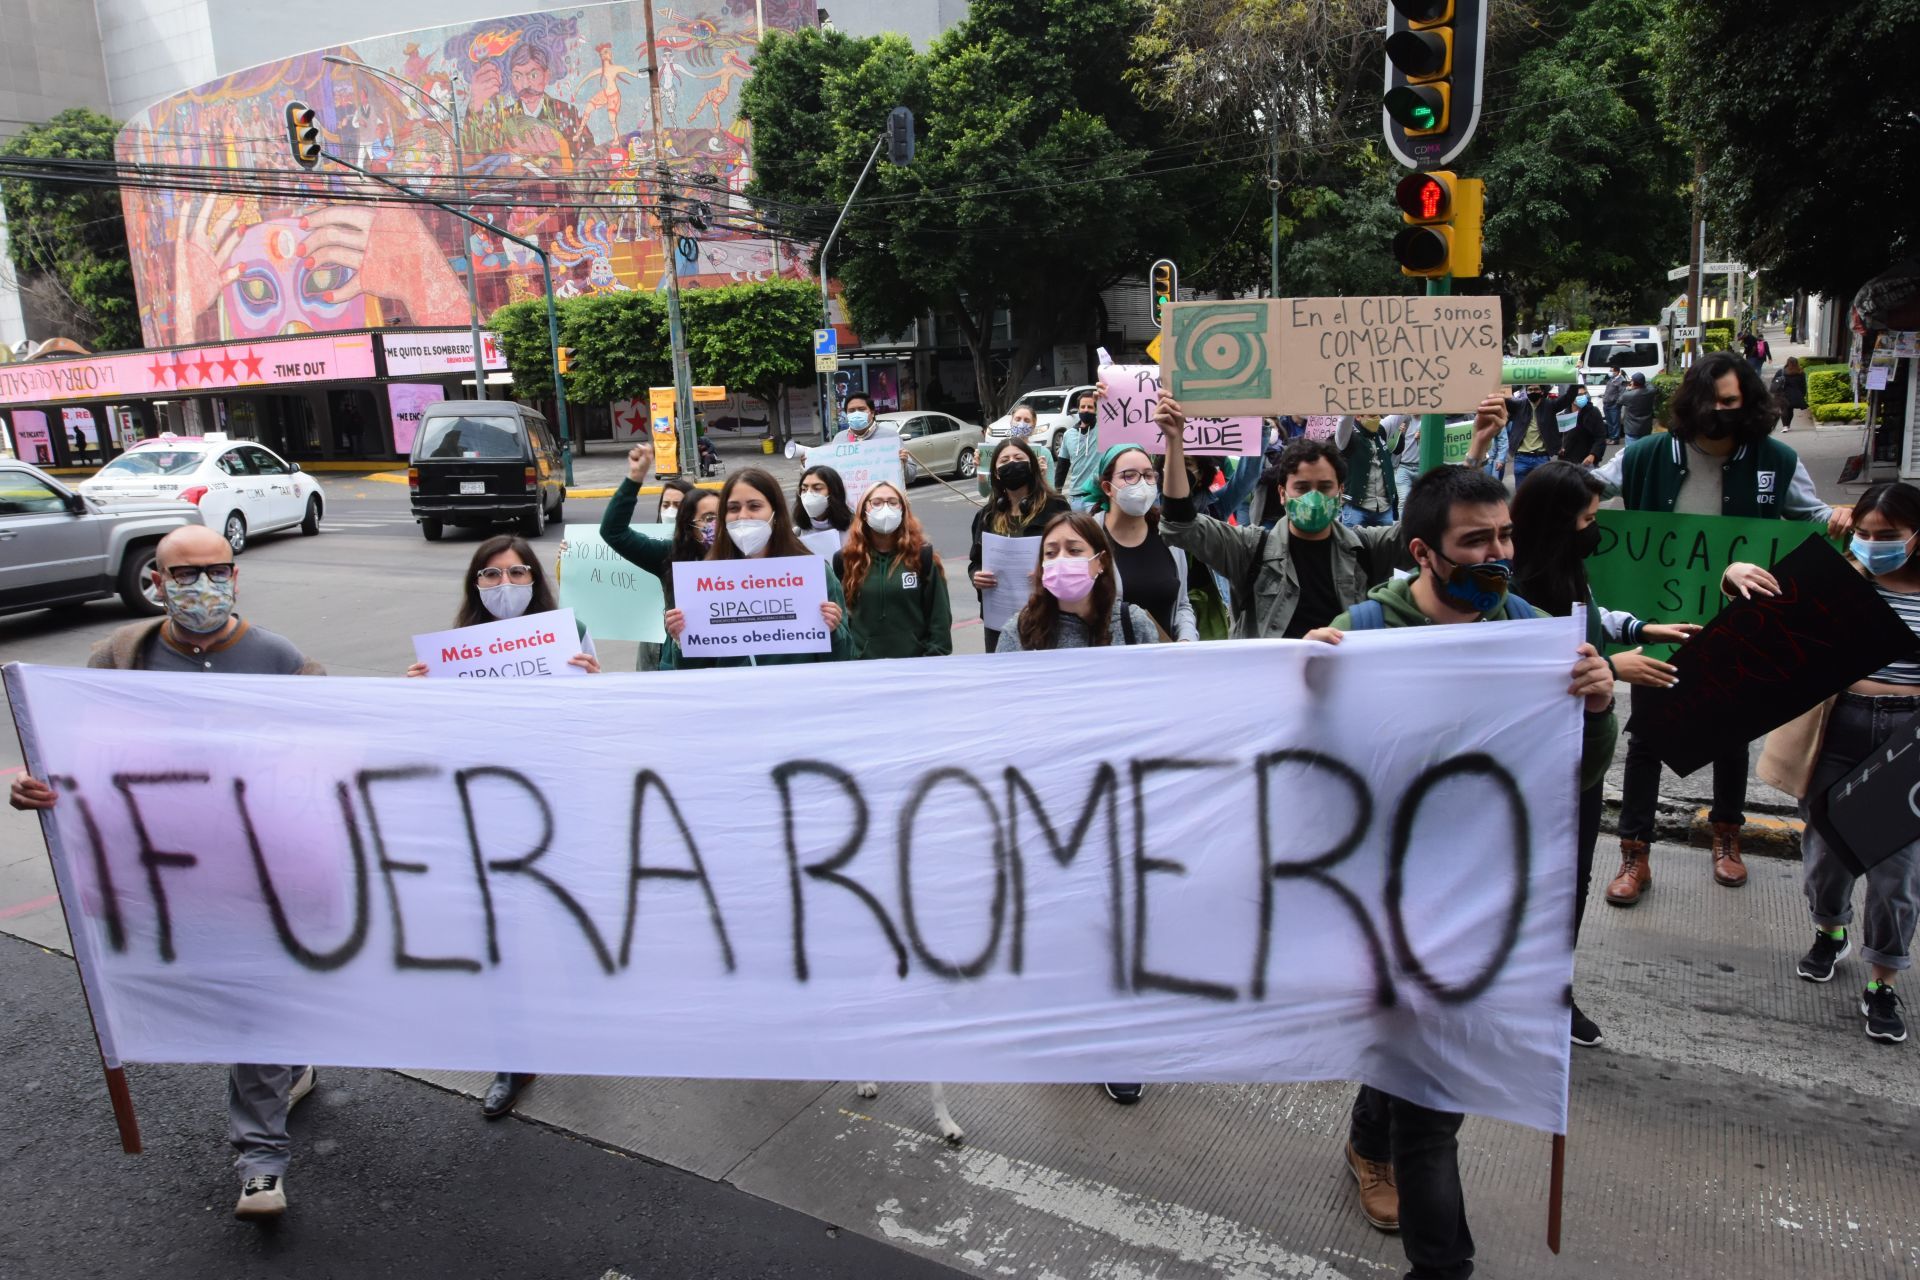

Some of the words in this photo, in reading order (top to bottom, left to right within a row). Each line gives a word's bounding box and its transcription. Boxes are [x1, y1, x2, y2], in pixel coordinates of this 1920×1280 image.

[1415, 144, 1440, 155] CDMX
[1292, 300, 1322, 327] En
[1334, 301, 1347, 325] el
[1361, 298, 1420, 326] CIDE
[1433, 306, 1491, 321] somos
[1320, 325, 1498, 359] COMBATIVXS,
[1679, 329, 1695, 337] TAXI
[399, 345, 421, 359] QUITO
[424, 345, 432, 356] EL
[304, 361, 326, 376] OUT
[1334, 356, 1450, 384] CRITICXS
[1468, 362, 1484, 376] &
[1513, 367, 1547, 380] CIDE
[51, 366, 98, 392] OBRA
[1319, 383, 1445, 412] "REBELDES"
[836, 444, 860, 458] CIDE
[575, 541, 590, 560] YO
[590, 567, 603, 584] AL
[611, 571, 638, 592] CIDE
[697, 576, 735, 592] Más
[741, 572, 804, 590] ciencia
[710, 598, 795, 617] SIPACIDE
[442, 643, 482, 662] Más
[489, 630, 555, 654] ciencia
[688, 633, 738, 646] Menos
[742, 627, 826, 644] obediencia
